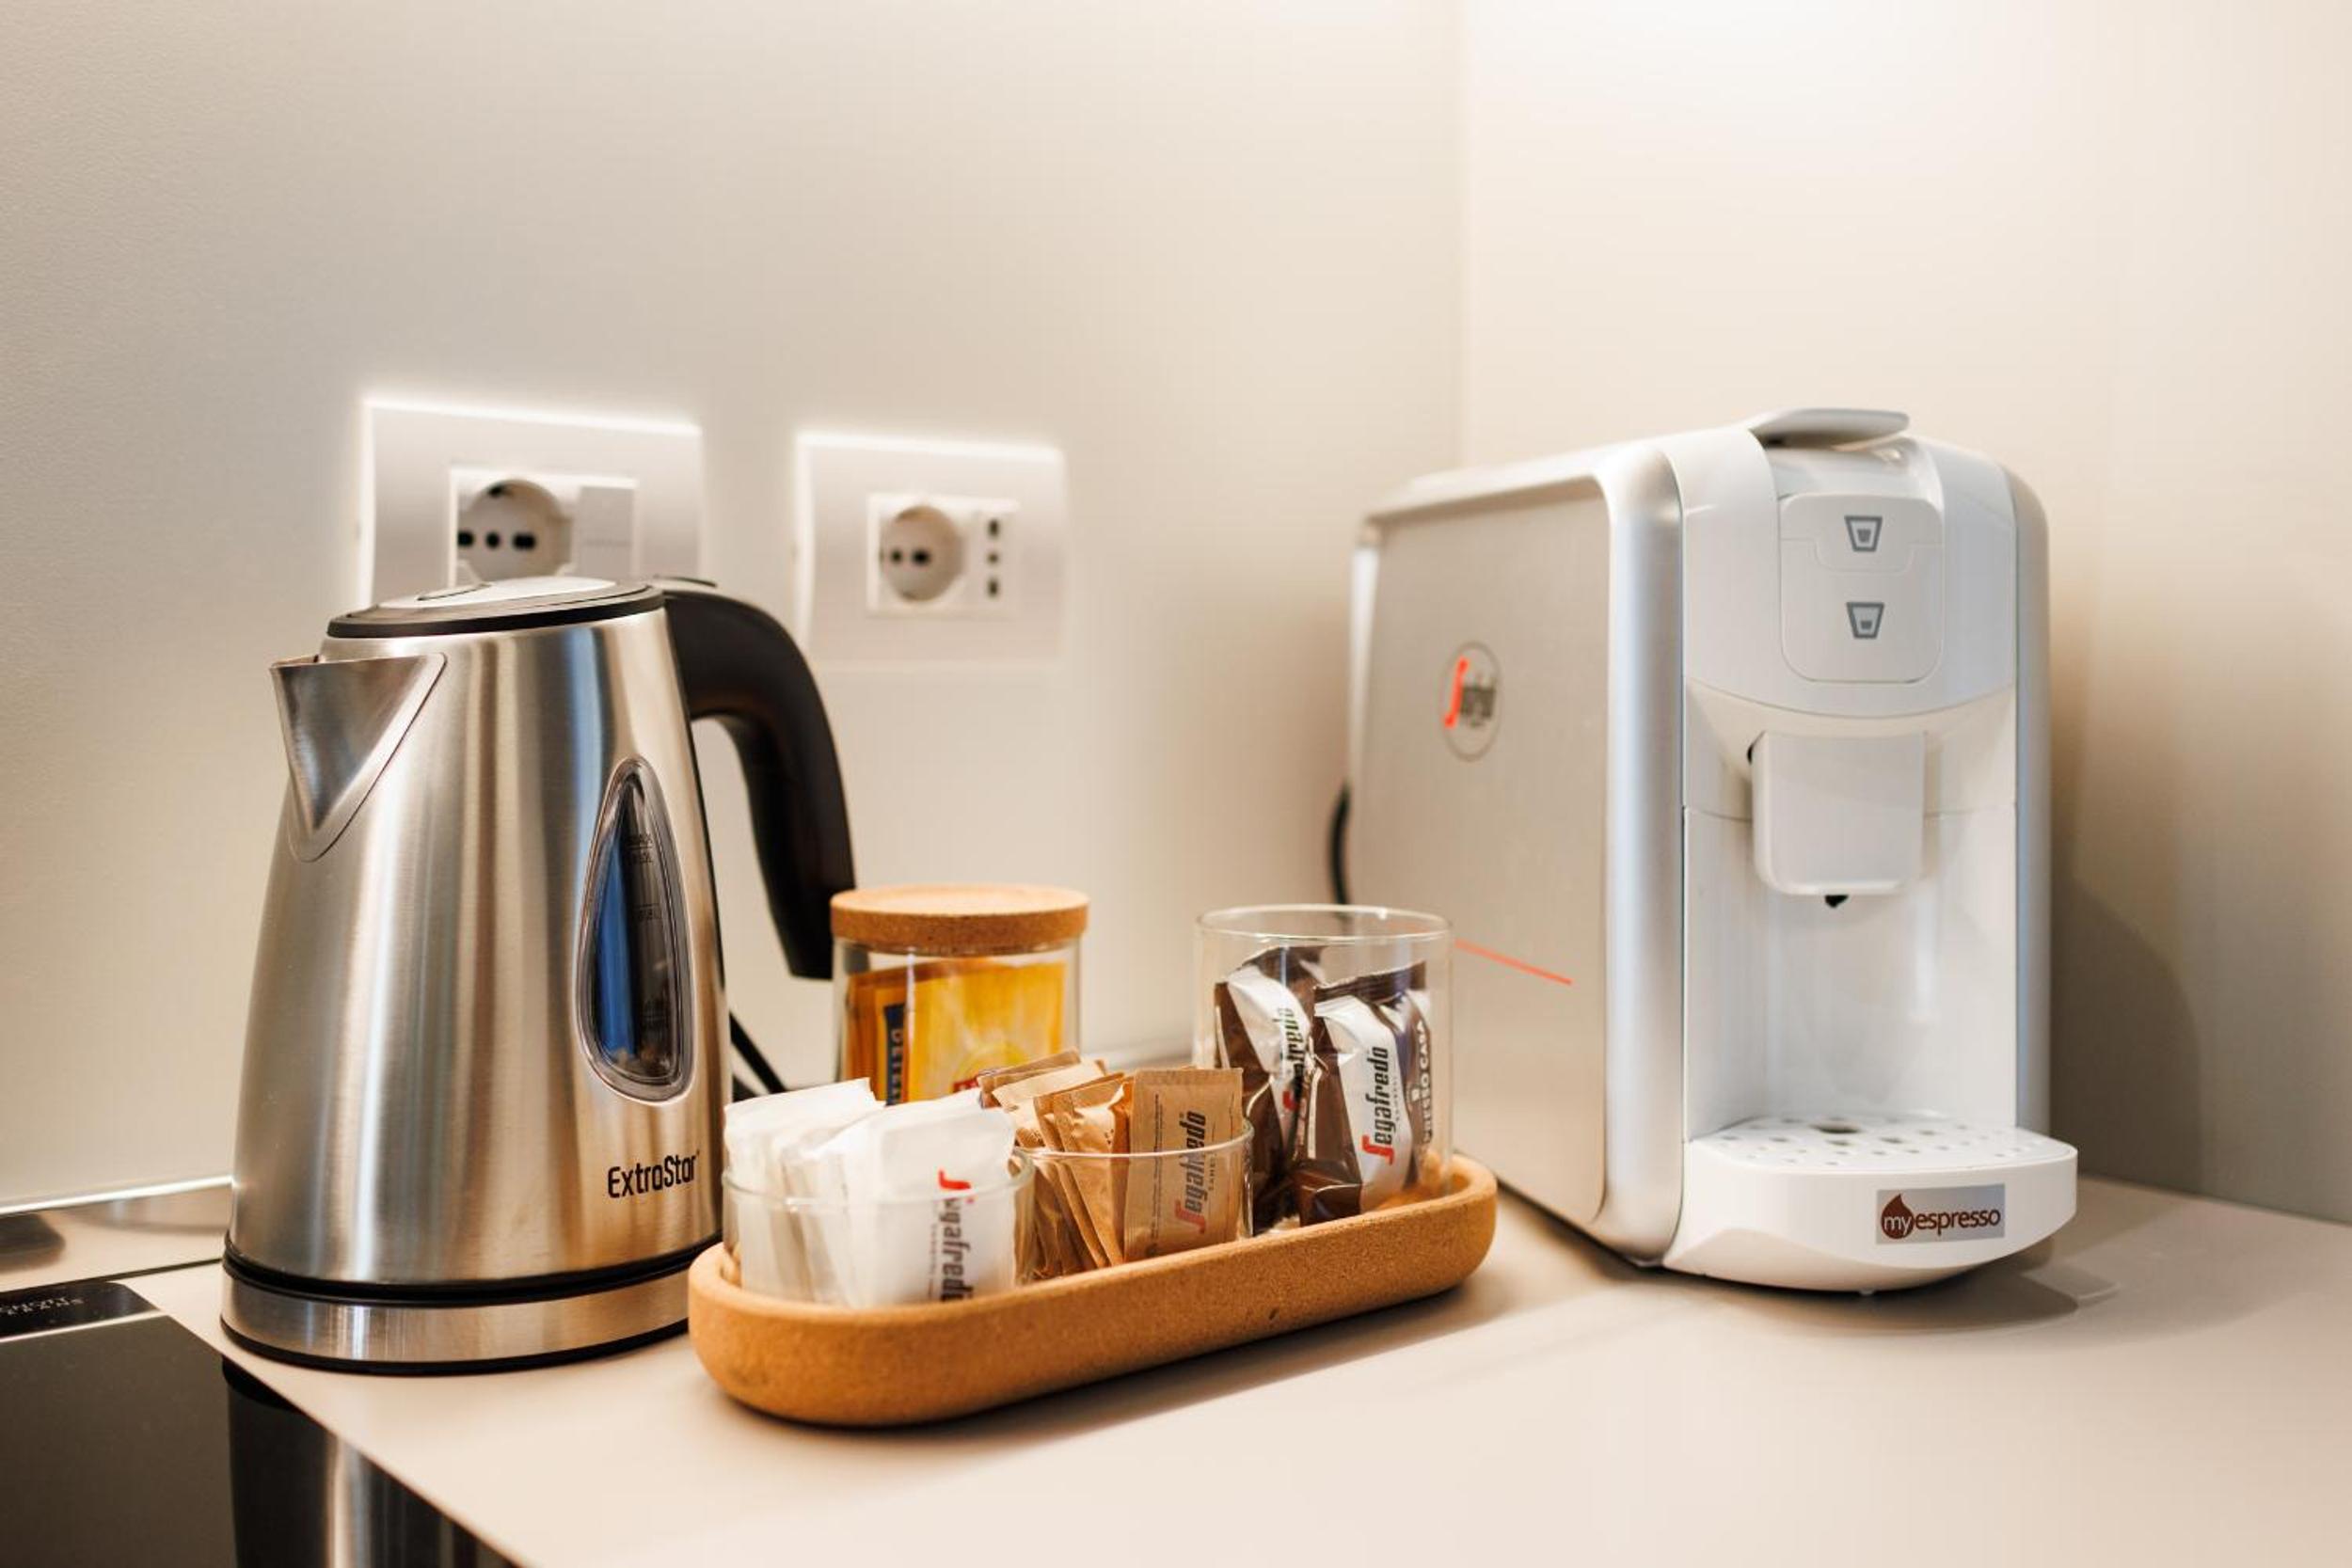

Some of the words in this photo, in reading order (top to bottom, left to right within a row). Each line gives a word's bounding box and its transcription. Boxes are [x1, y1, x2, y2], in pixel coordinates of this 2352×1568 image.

[1361, 1046, 1396, 1165] Segafredo
[608, 1154, 696, 1198] ExtraStar
[1175, 1111, 1207, 1234] Segafedo
